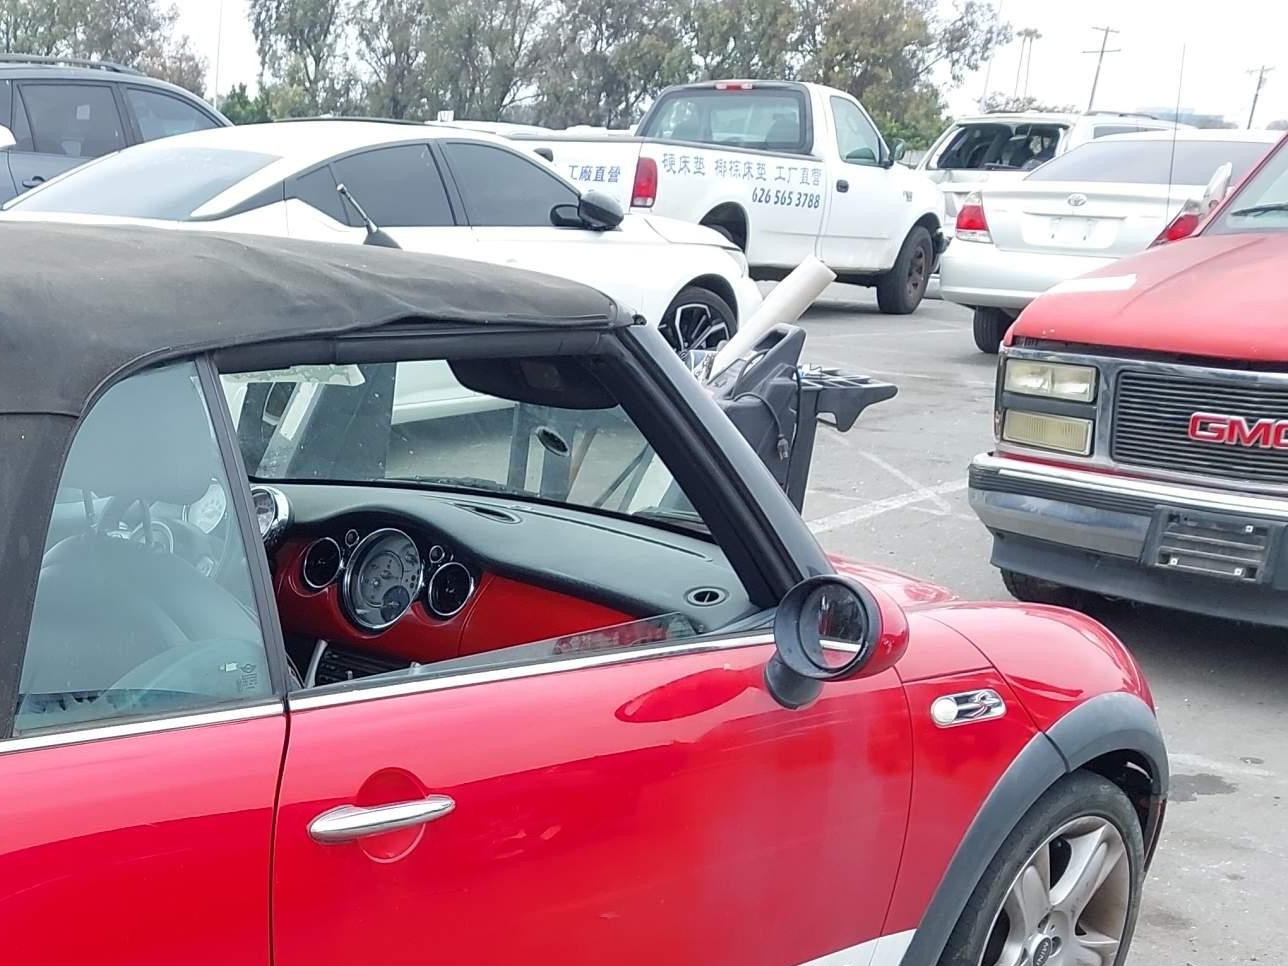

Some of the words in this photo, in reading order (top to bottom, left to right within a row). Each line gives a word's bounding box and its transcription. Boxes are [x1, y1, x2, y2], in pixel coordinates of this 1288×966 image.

[774, 165, 823, 187] 工厂直营
[752, 187, 771, 204] 626
[774, 189, 793, 207] 565
[795, 191, 821, 208] 3788
